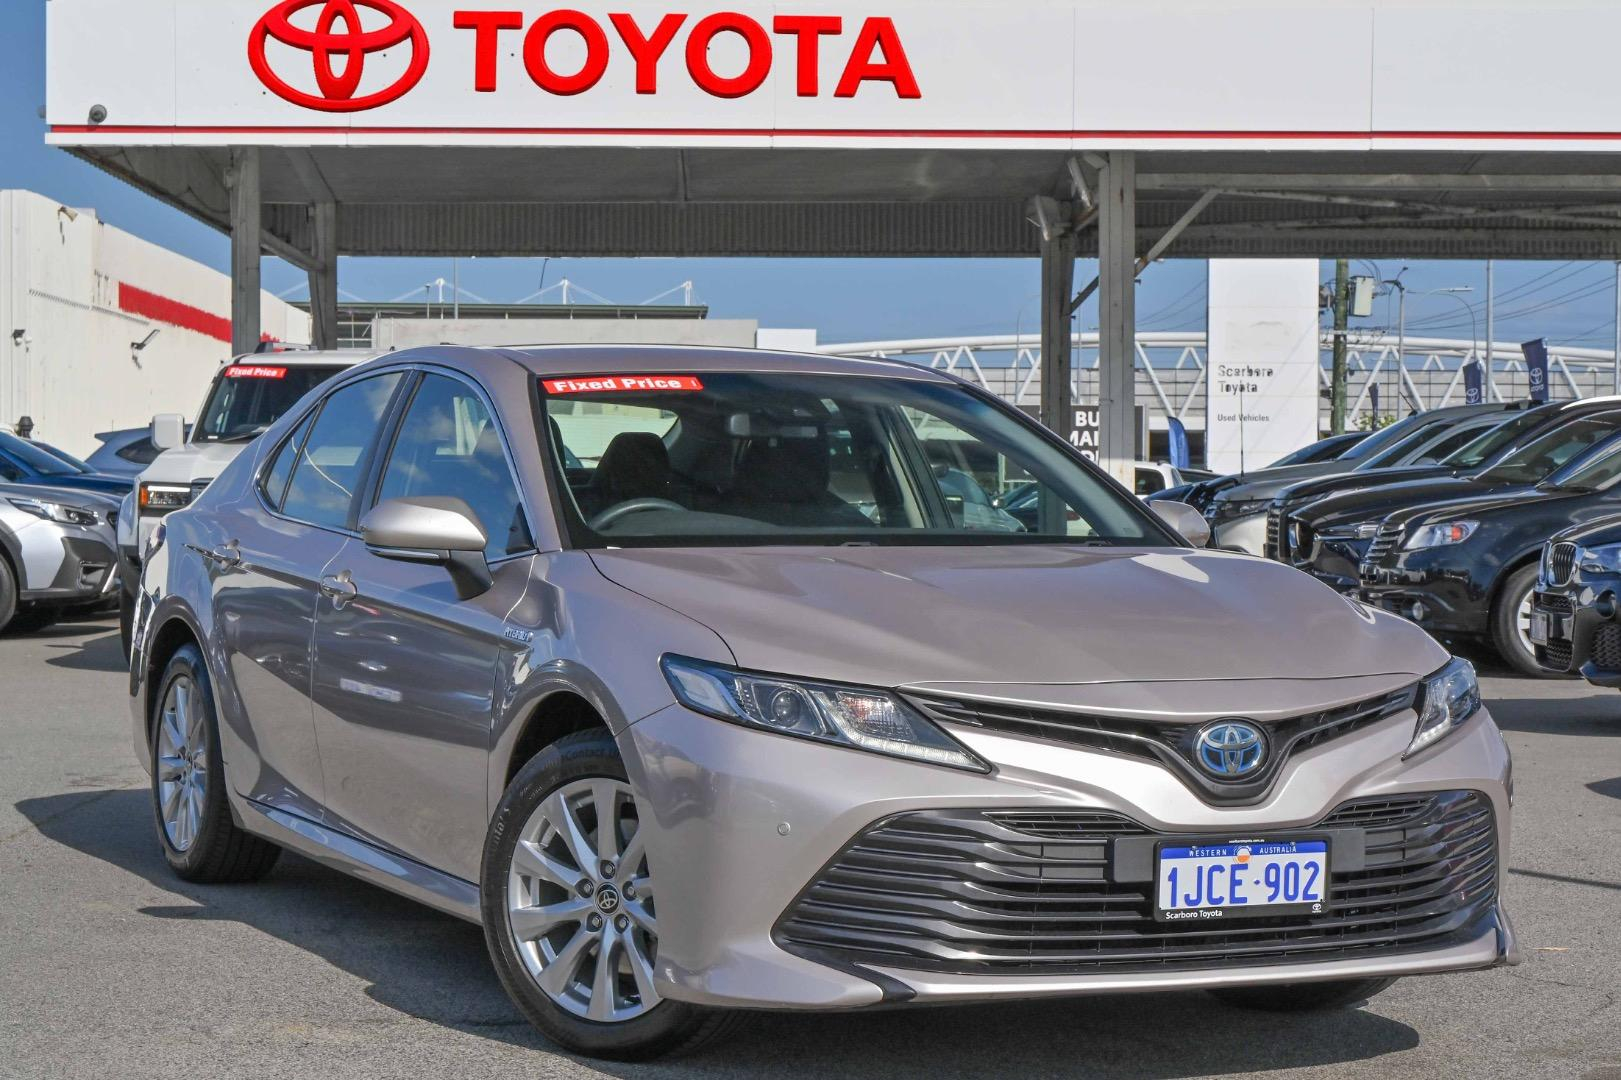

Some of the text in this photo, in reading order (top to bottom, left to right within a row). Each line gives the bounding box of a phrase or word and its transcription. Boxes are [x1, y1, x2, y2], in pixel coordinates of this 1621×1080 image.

[453, 9, 922, 99] TOYOTA
[553, 377, 682, 392] Fixed Price
[1218, 380, 1258, 395] Toyota
[1217, 413, 1270, 422] Used Vehicles
[1189, 846, 1297, 857] WESTERN AUSTRALIA
[1165, 909, 1223, 920] Scarboro Toyota
